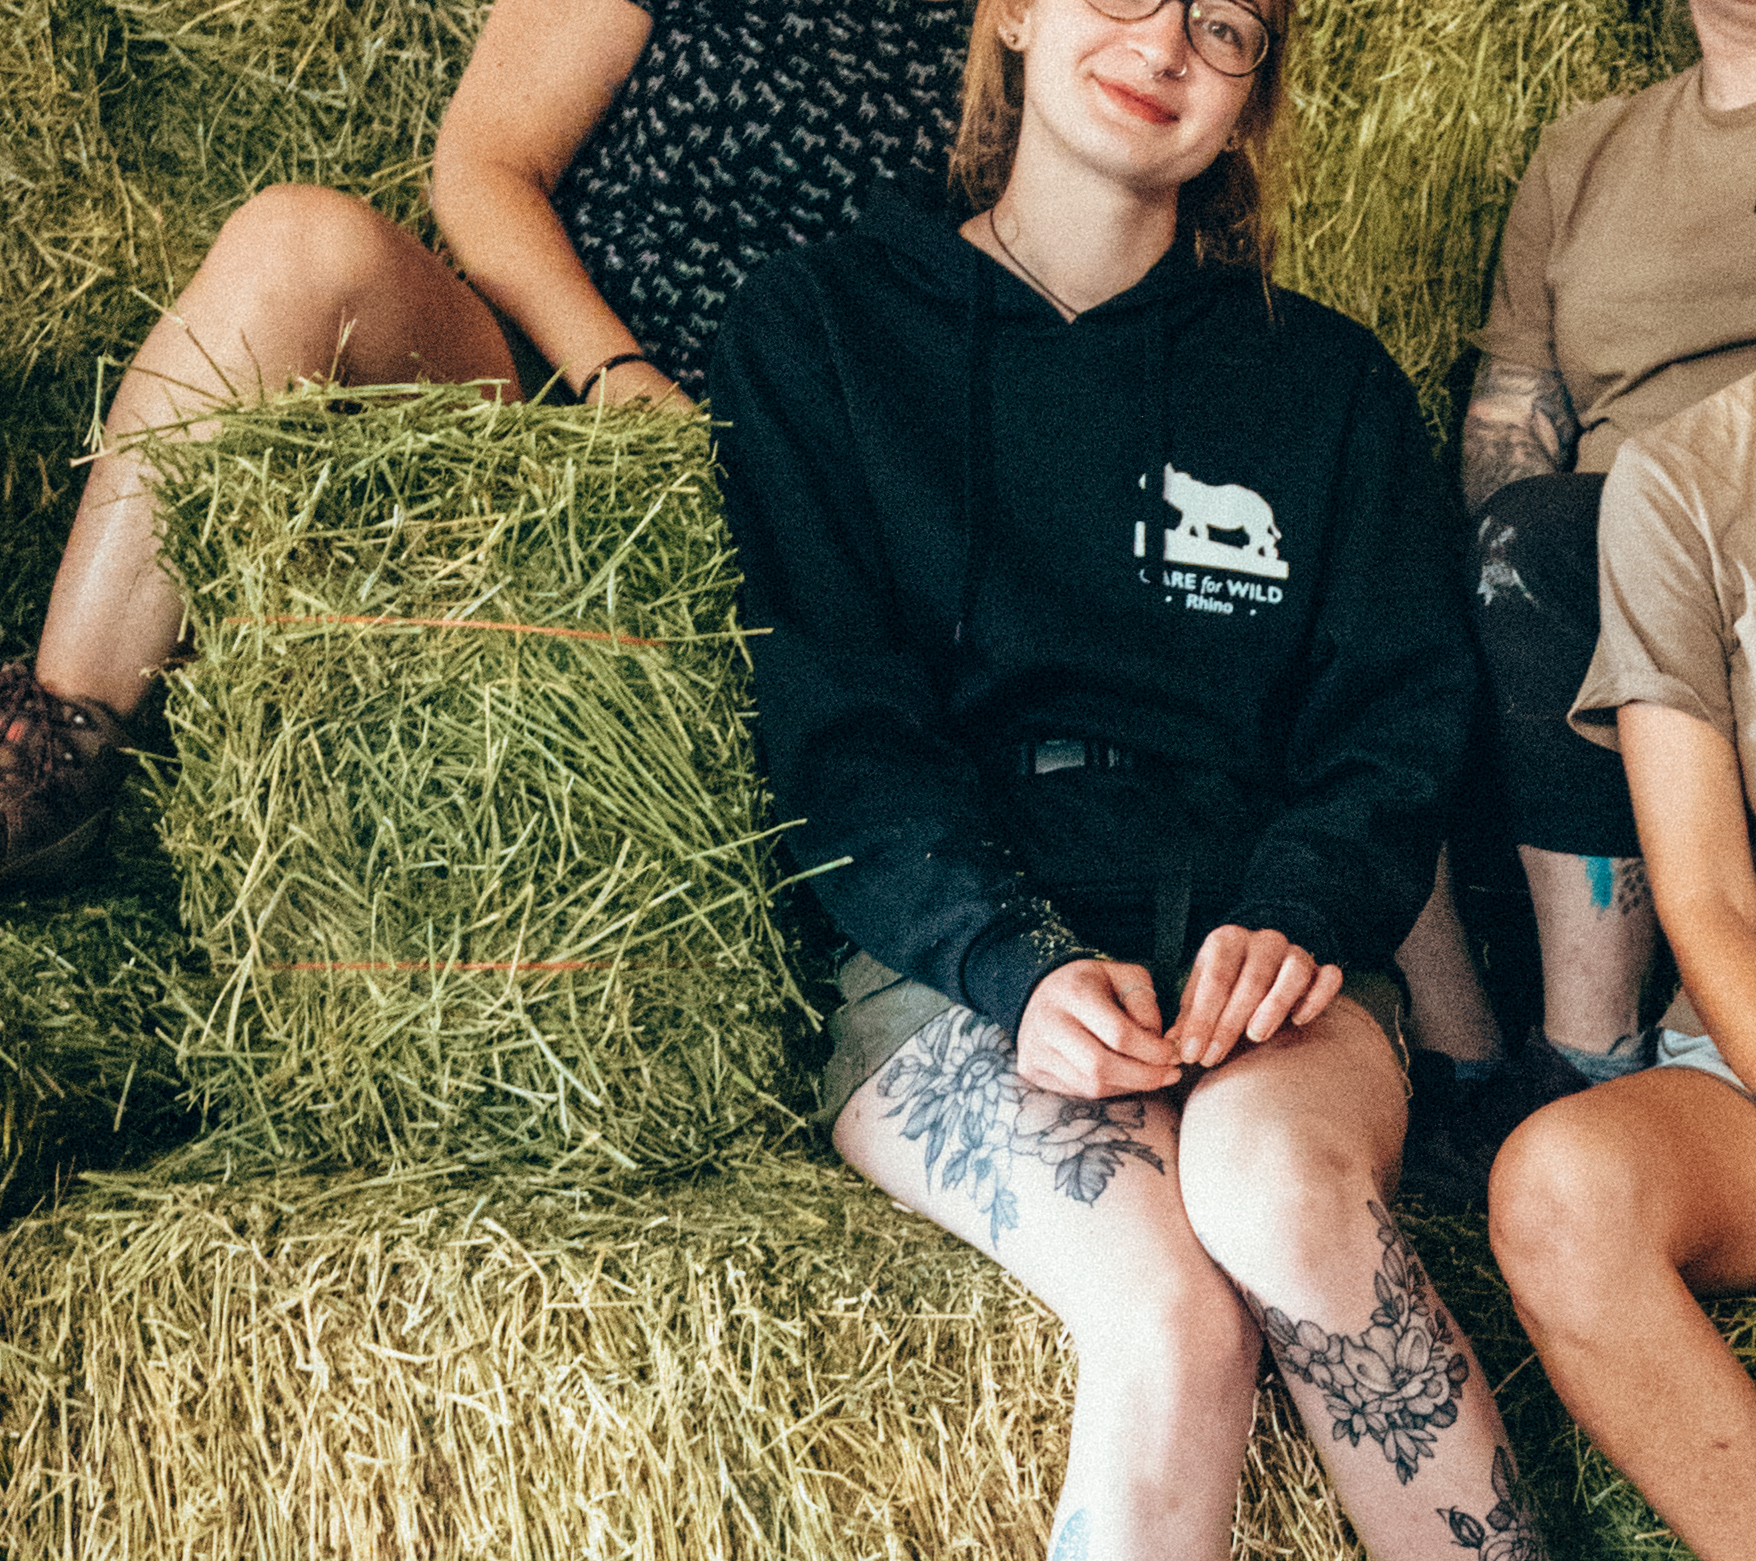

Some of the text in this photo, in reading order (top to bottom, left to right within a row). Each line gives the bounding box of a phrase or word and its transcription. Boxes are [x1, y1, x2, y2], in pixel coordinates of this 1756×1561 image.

[1200, 575, 1223, 595] for
[1226, 579, 1283, 604] WILD
[1185, 593, 1234, 615] Rhino
